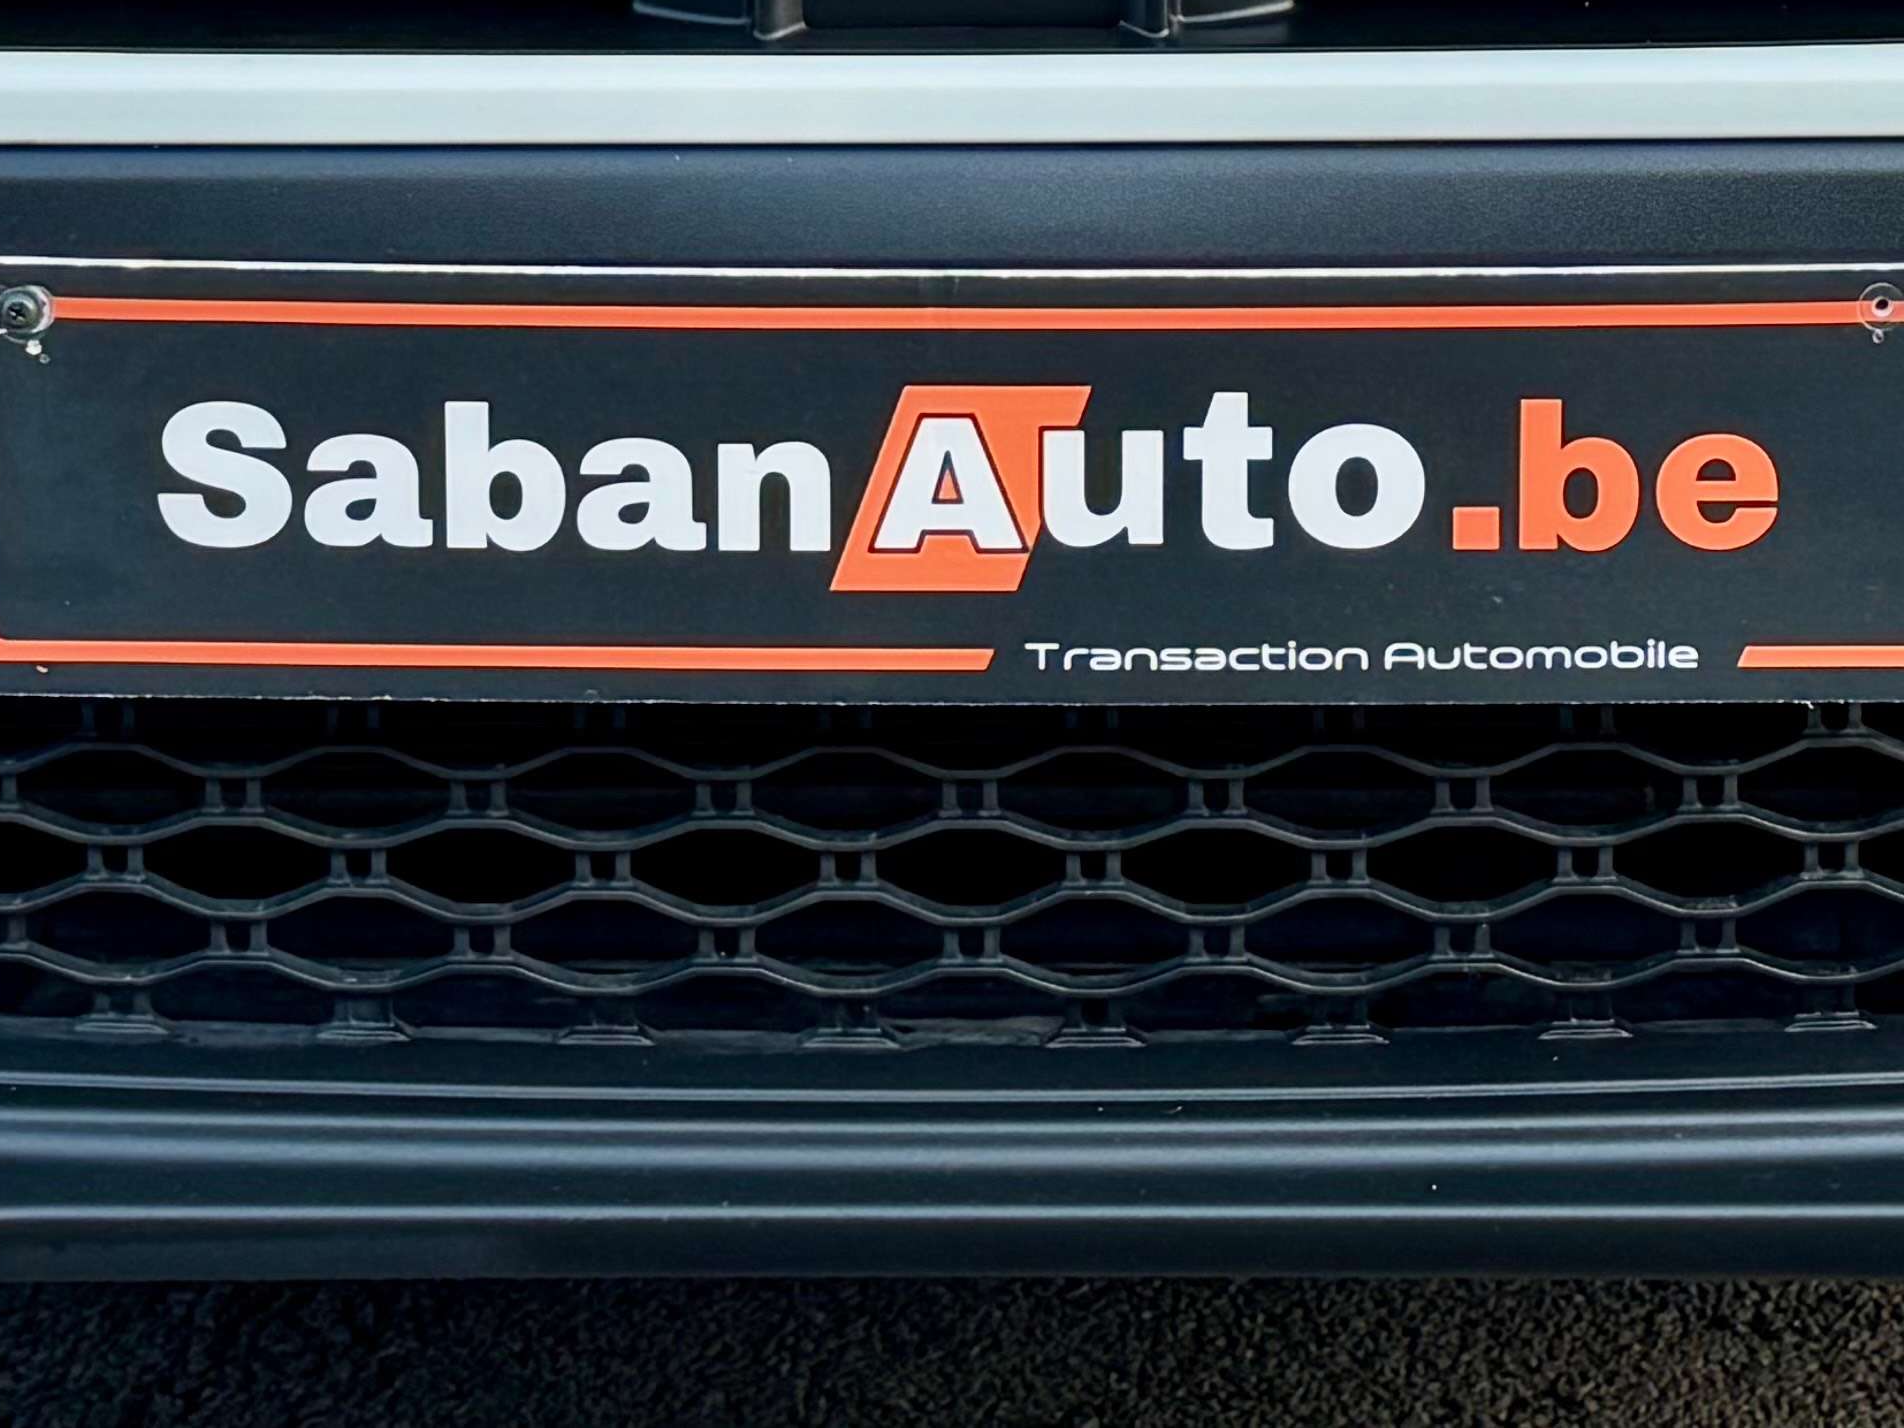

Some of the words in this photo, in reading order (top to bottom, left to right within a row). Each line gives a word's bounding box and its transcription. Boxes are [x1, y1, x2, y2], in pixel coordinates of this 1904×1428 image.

[156, 391, 1780, 553] SabanAuto.be
[1024, 640, 1370, 672] Transaction
[1383, 638, 1700, 671] Automobile
